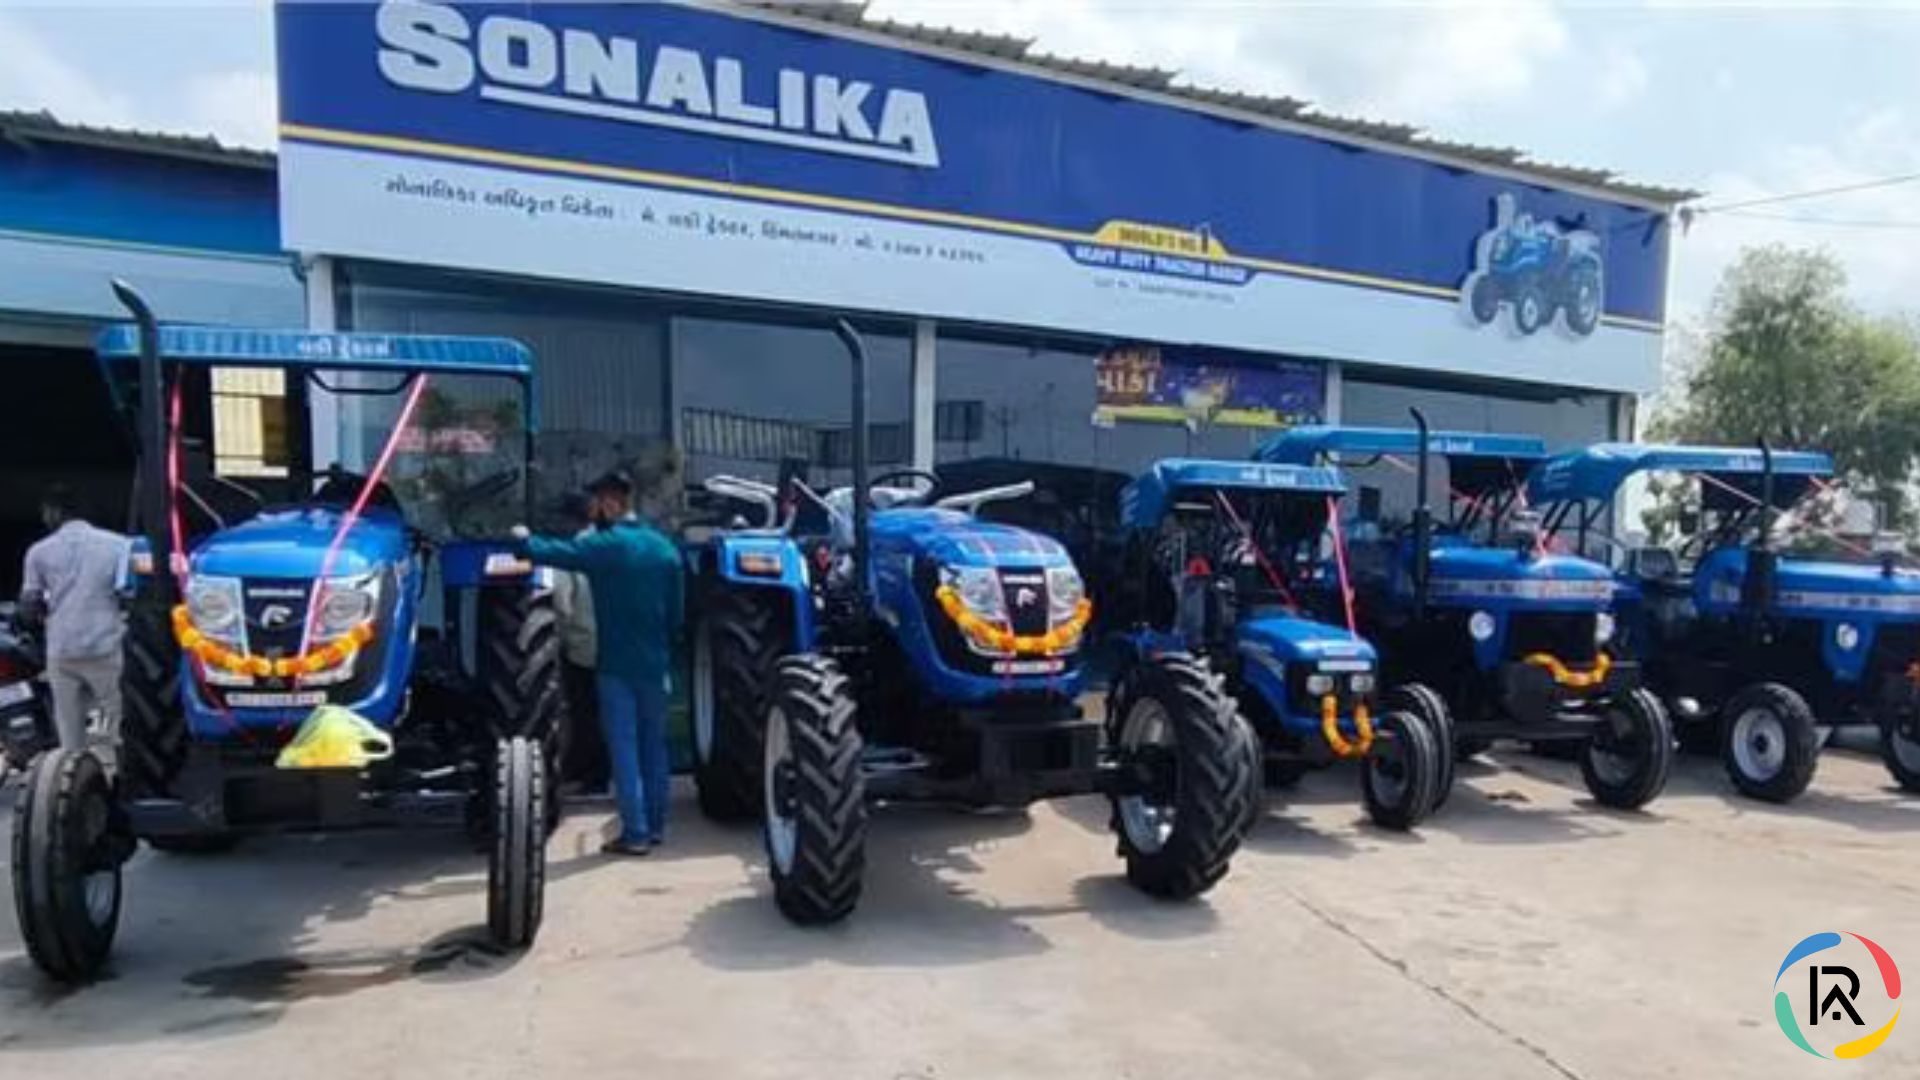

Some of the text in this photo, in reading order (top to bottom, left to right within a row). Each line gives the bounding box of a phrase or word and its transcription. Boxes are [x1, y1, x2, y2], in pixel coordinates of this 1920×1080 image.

[376, 0, 939, 167] SONALIKA
[1074, 246, 1116, 265] HEAVY
[1119, 251, 1151, 270] DUTY
